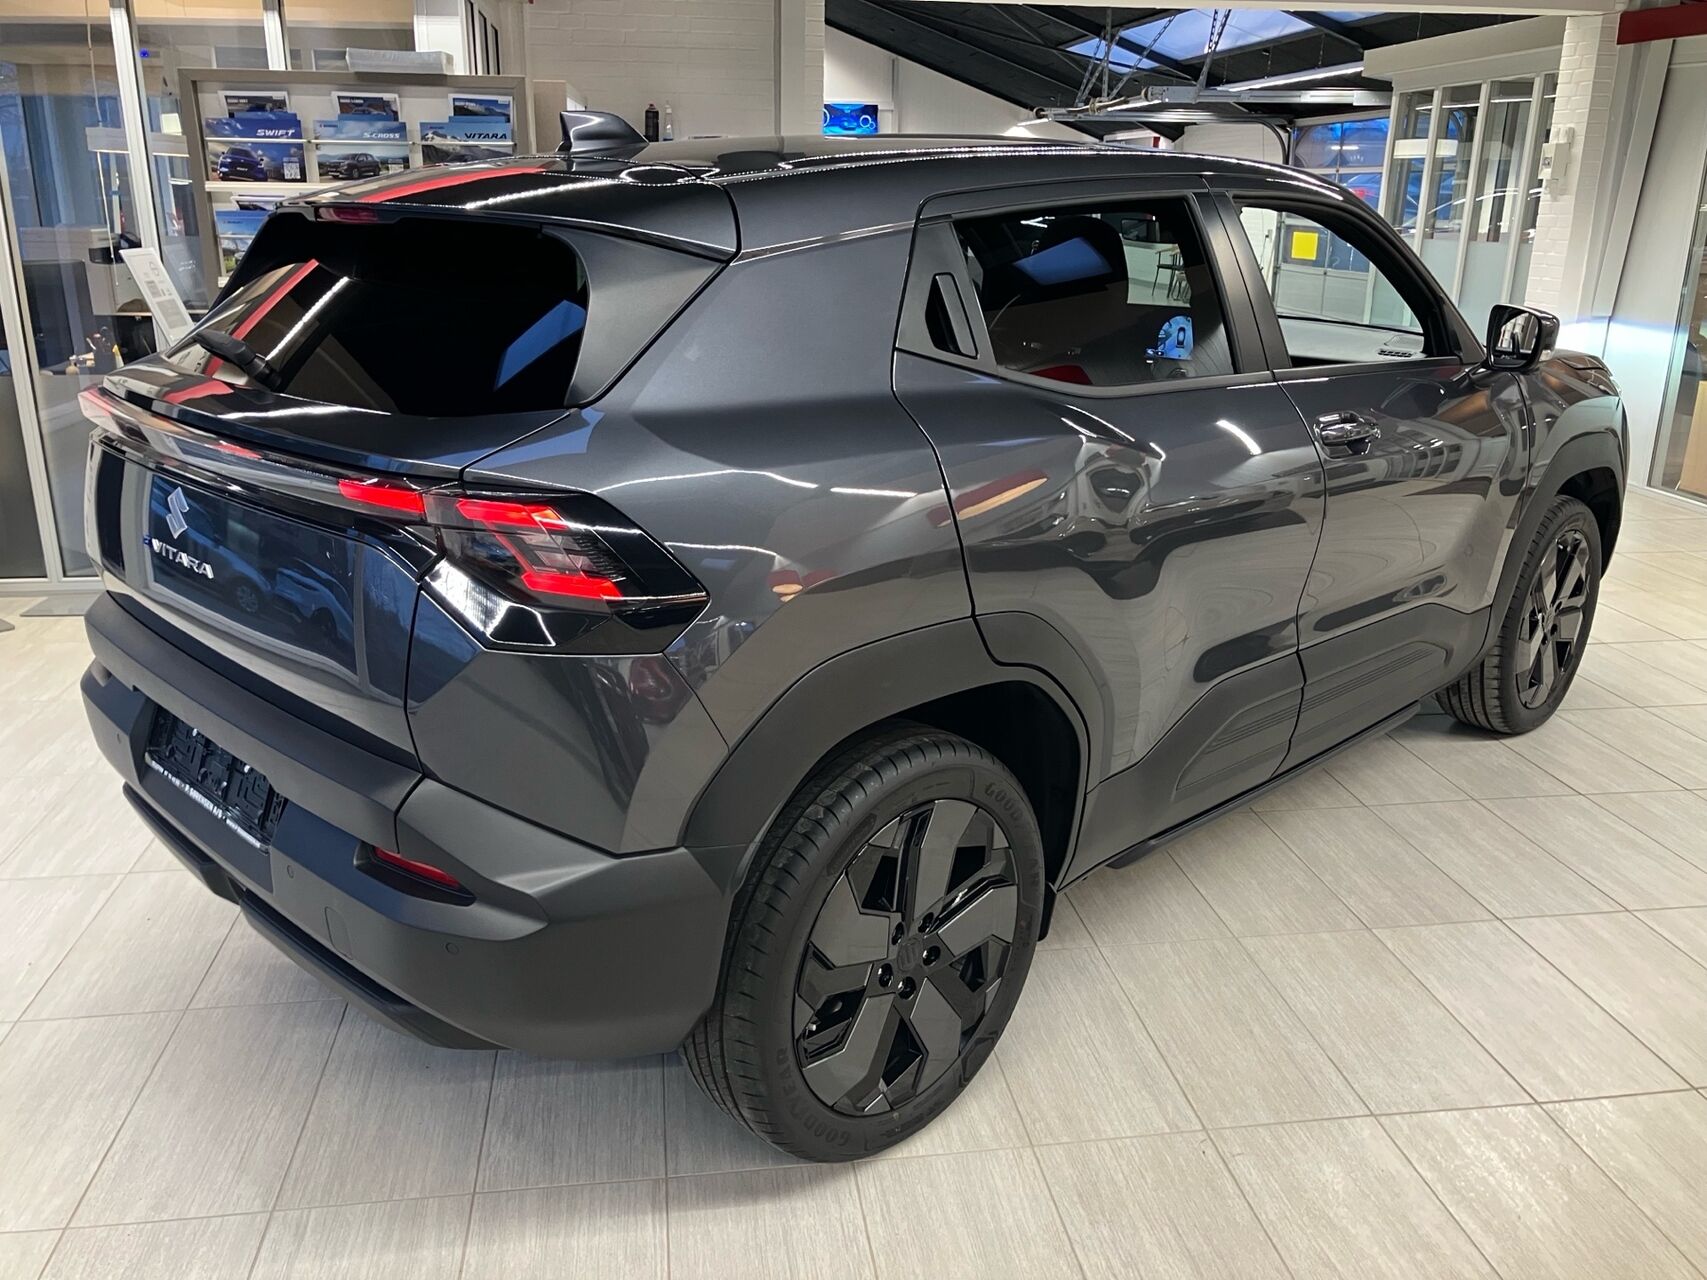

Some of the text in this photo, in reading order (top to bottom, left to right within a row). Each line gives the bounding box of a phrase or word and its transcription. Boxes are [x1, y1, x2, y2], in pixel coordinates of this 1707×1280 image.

[256, 129, 296, 137] SWIFT
[464, 132, 507, 140] VITARA
[151, 538, 215, 579] VITARA
